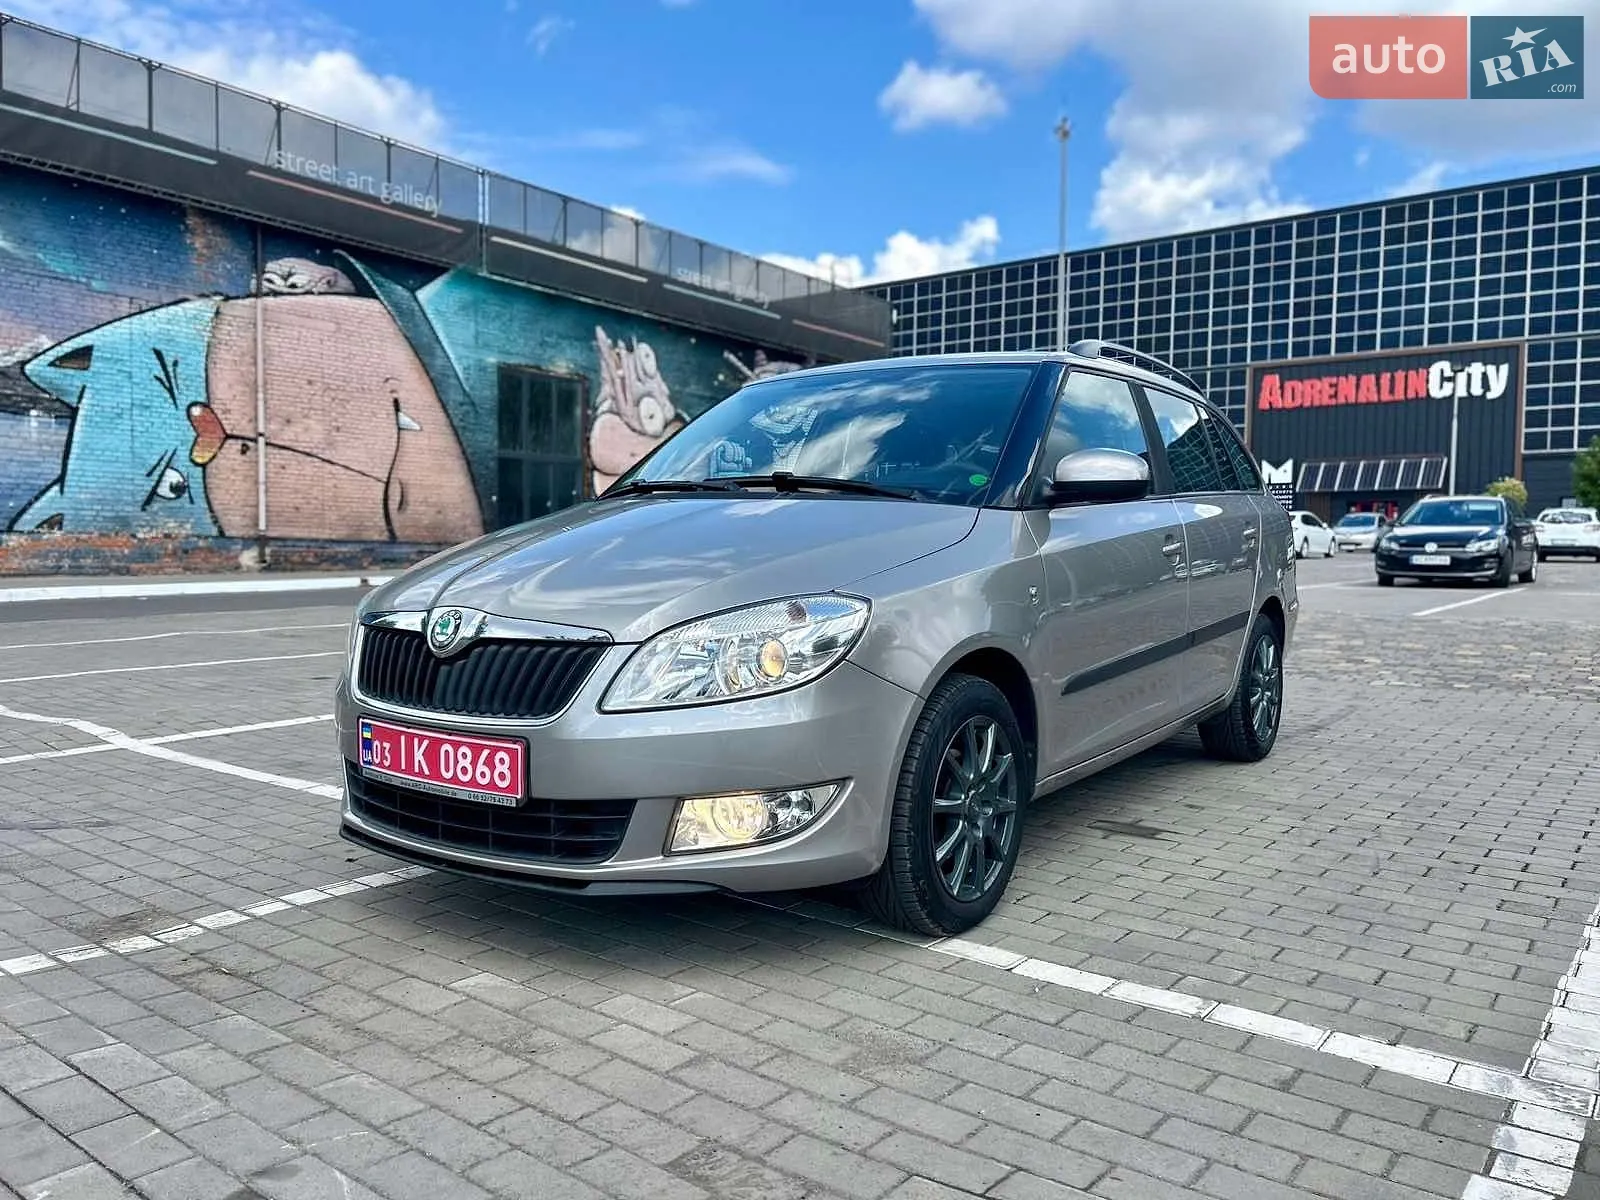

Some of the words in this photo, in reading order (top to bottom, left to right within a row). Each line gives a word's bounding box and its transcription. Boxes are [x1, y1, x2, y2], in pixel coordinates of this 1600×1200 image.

[346, 170, 376, 195] art
[380, 181, 442, 218] gallery
[363, 749, 373, 763] UA
[373, 740, 391, 767] 03
[400, 735, 430, 776] IK
[439, 743, 511, 788] 0868
